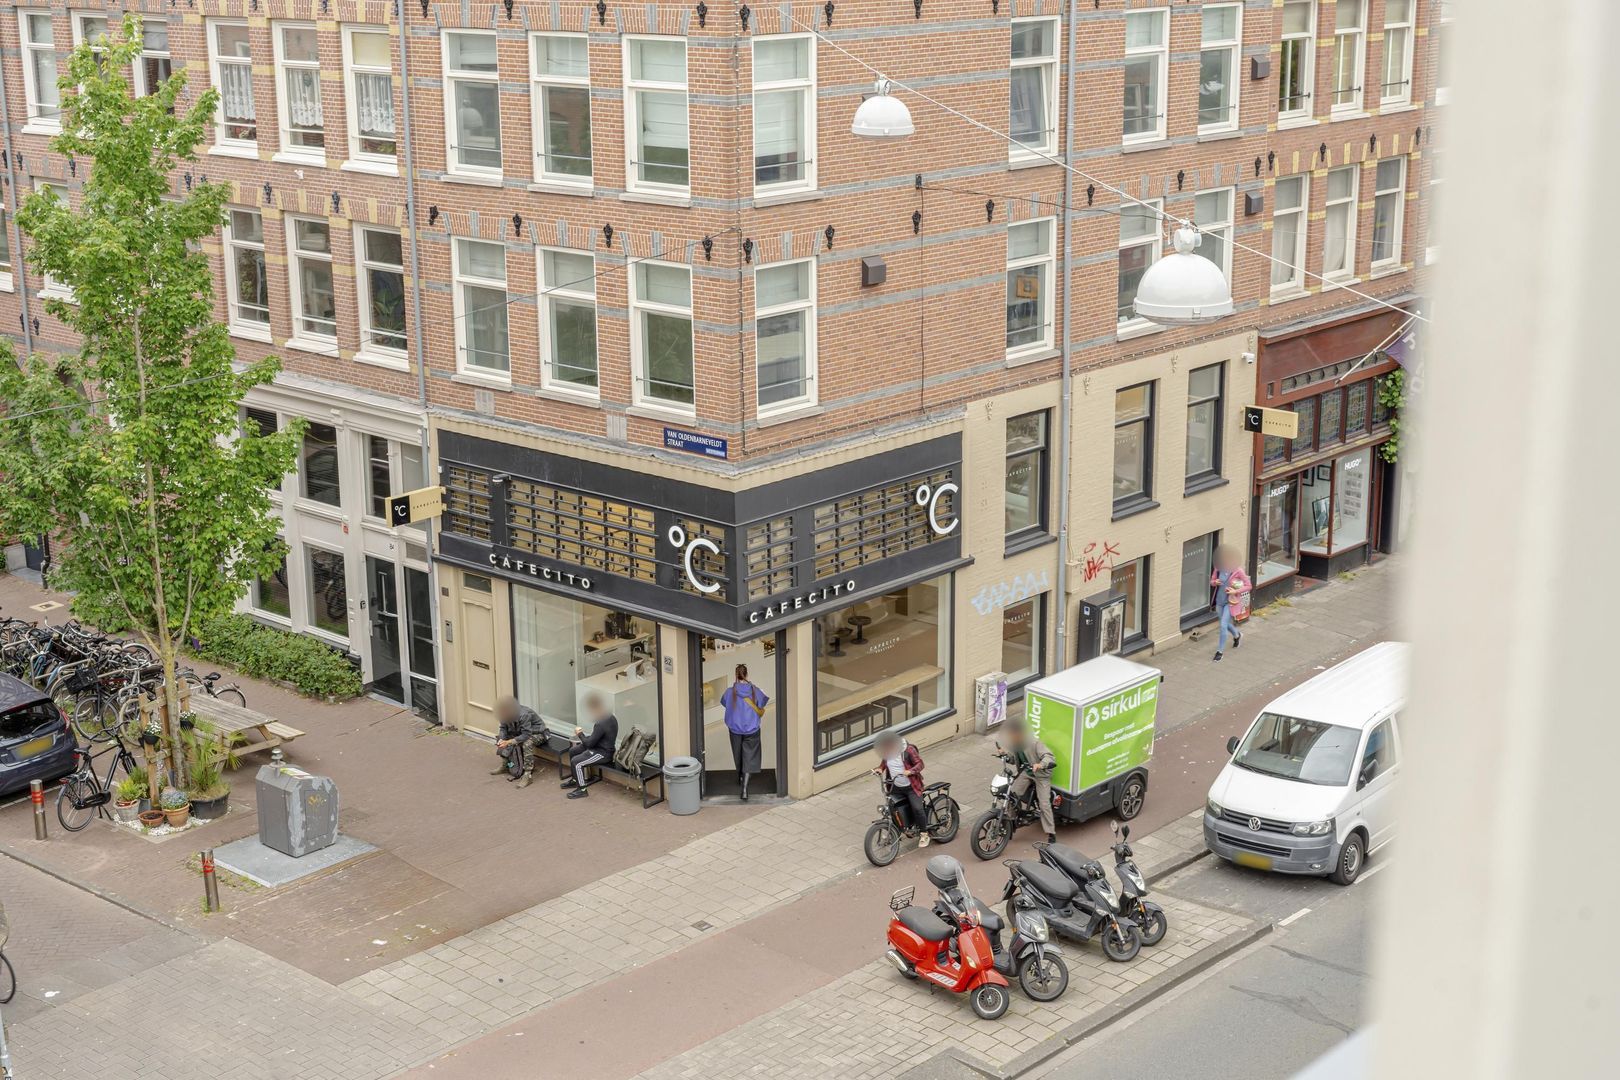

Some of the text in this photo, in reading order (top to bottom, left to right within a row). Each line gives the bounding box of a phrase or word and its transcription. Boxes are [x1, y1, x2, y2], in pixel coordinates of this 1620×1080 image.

[667, 430, 723, 448] VAN OLDENBARNEVELDT
[667, 438, 684, 448] STRAAT
[489, 553, 591, 589] CAFECITO
[749, 580, 856, 623] CAFECITO
